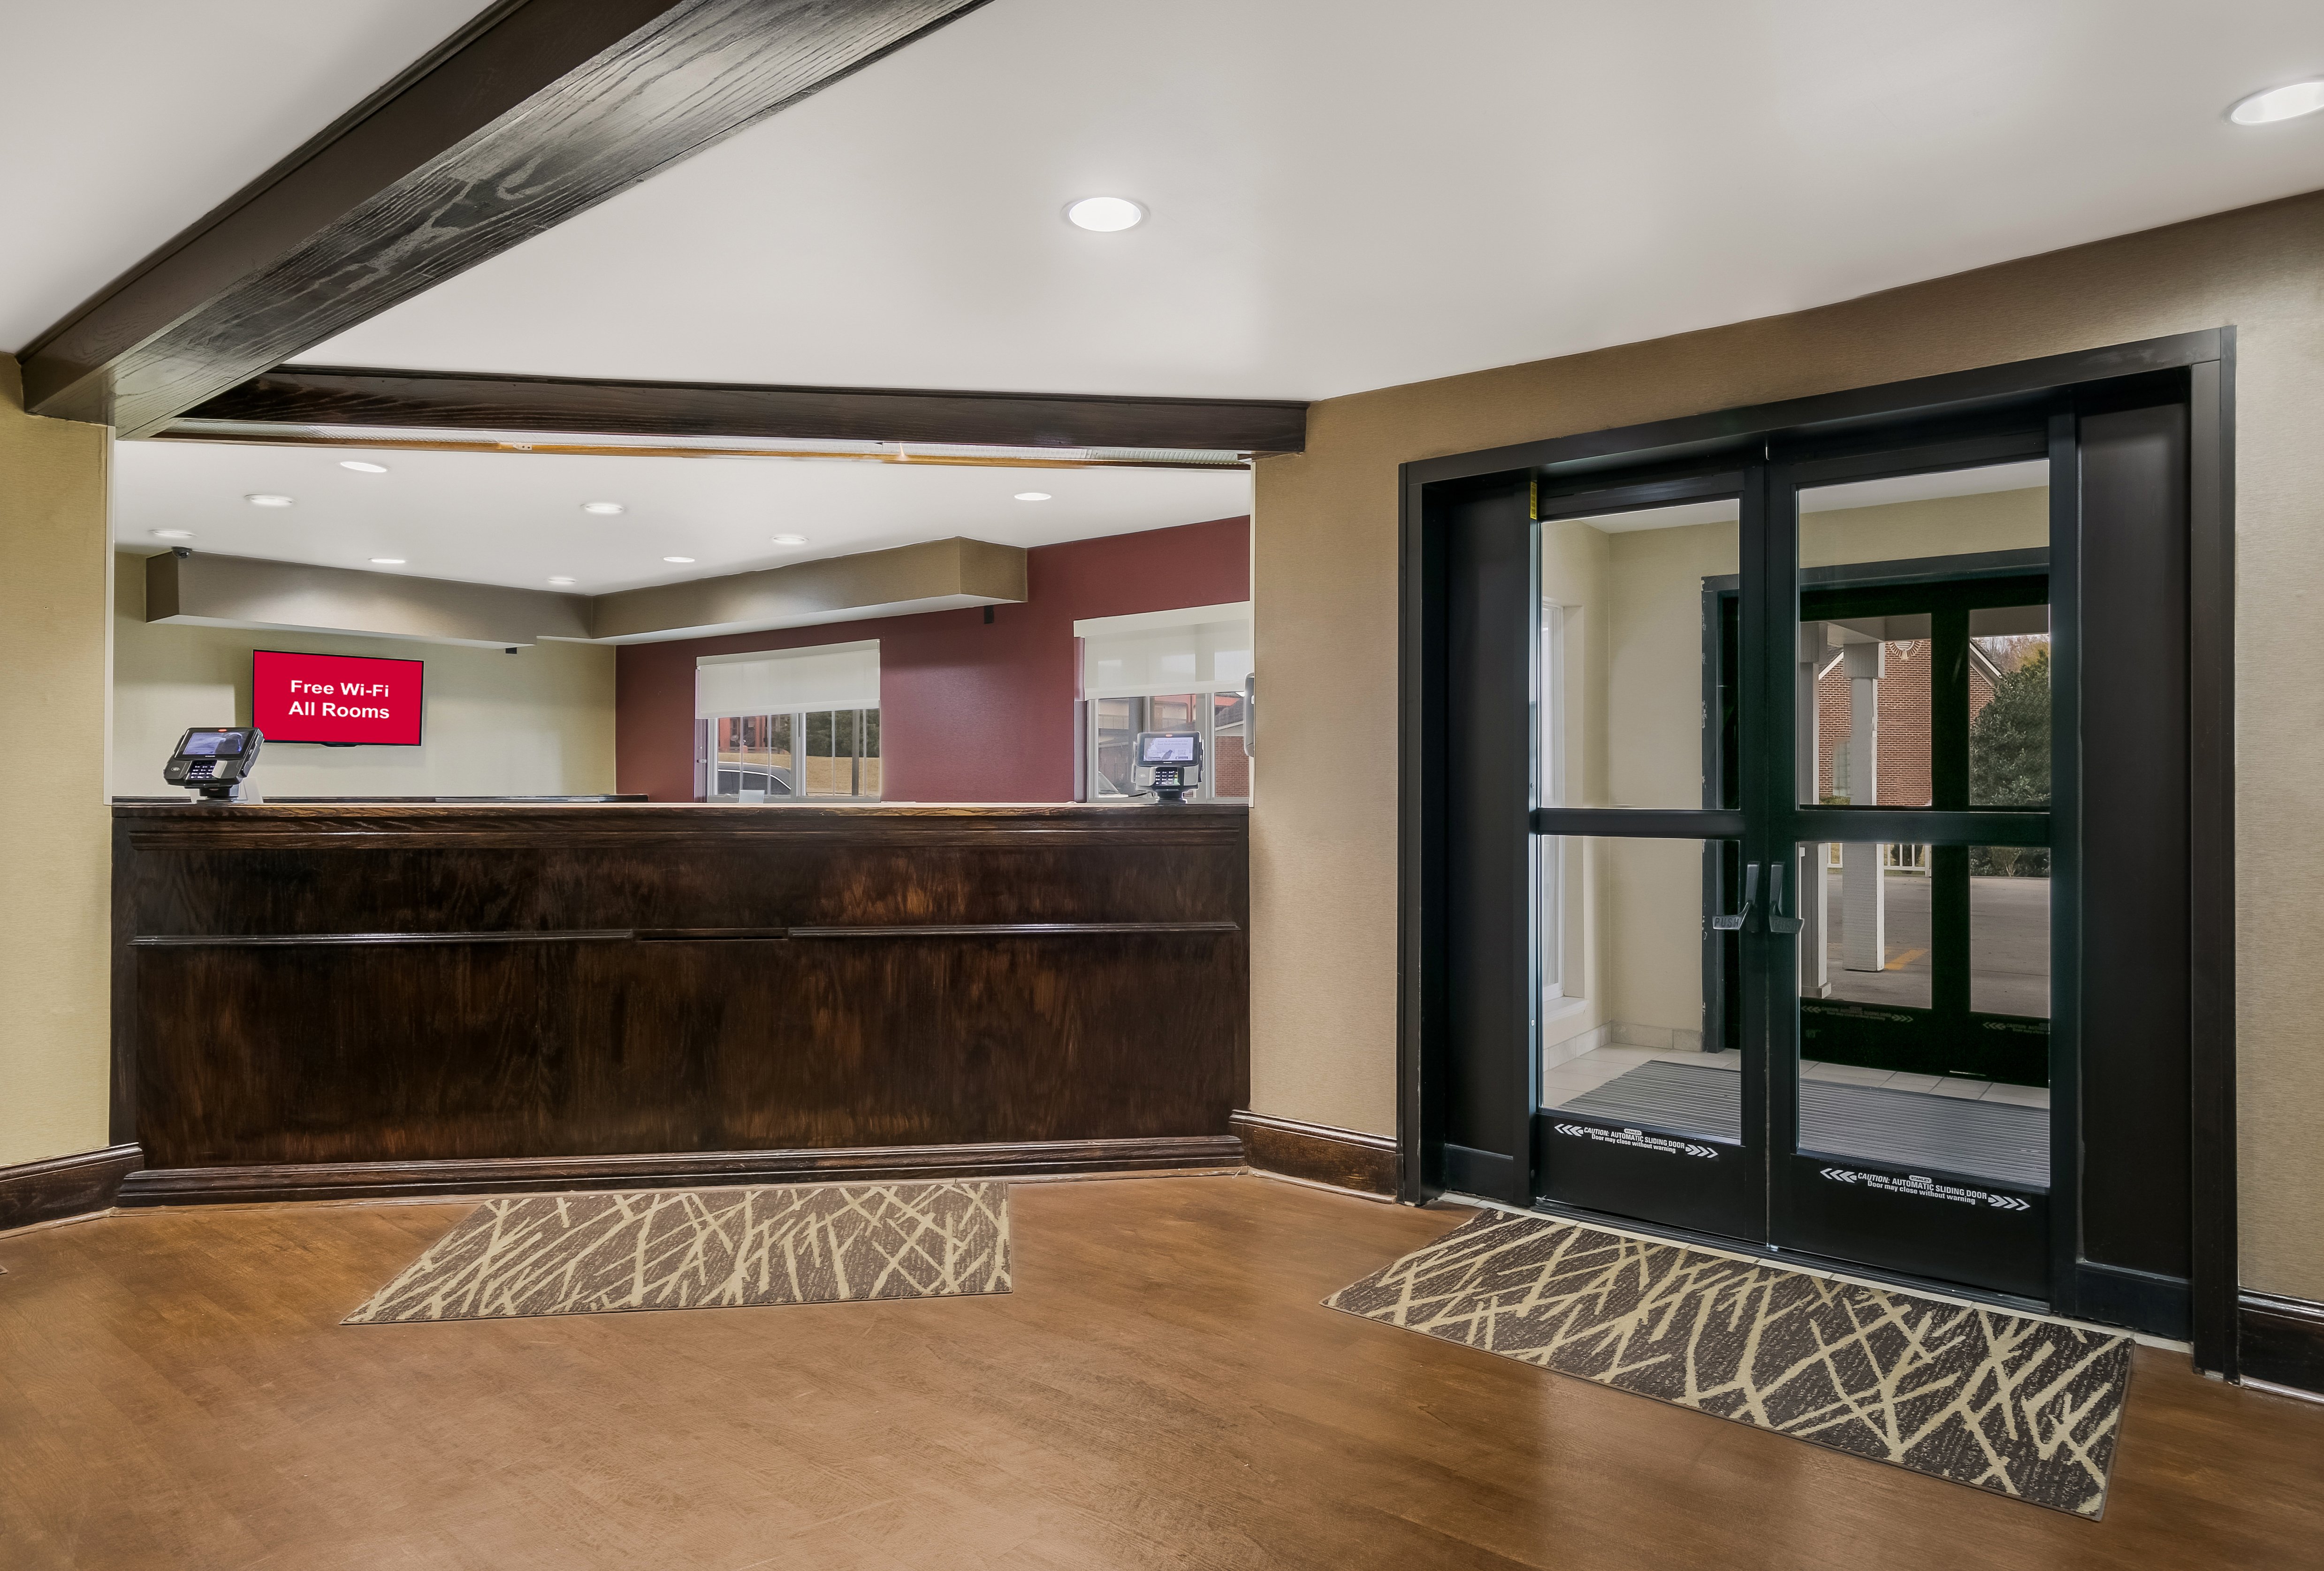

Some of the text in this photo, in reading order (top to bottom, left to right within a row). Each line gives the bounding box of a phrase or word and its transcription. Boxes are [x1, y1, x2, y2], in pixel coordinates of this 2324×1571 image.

[290, 680, 389, 697] Free Wi-Fi
[288, 701, 390, 719] All Rooms
[1714, 916, 1740, 928] PUSH
[1772, 919, 1799, 930] PUSH
[1584, 1127, 1685, 1149] CAUTION: AUTOMATIC SLIDING DOOR
[1653, 1145, 1676, 1154] warning
[1858, 1173, 1987, 1199] CAUTION: AUTOMATIC SLIDING DOOR
[1919, 1190, 1945, 1199] without
[1946, 1195, 1975, 1205] warning
